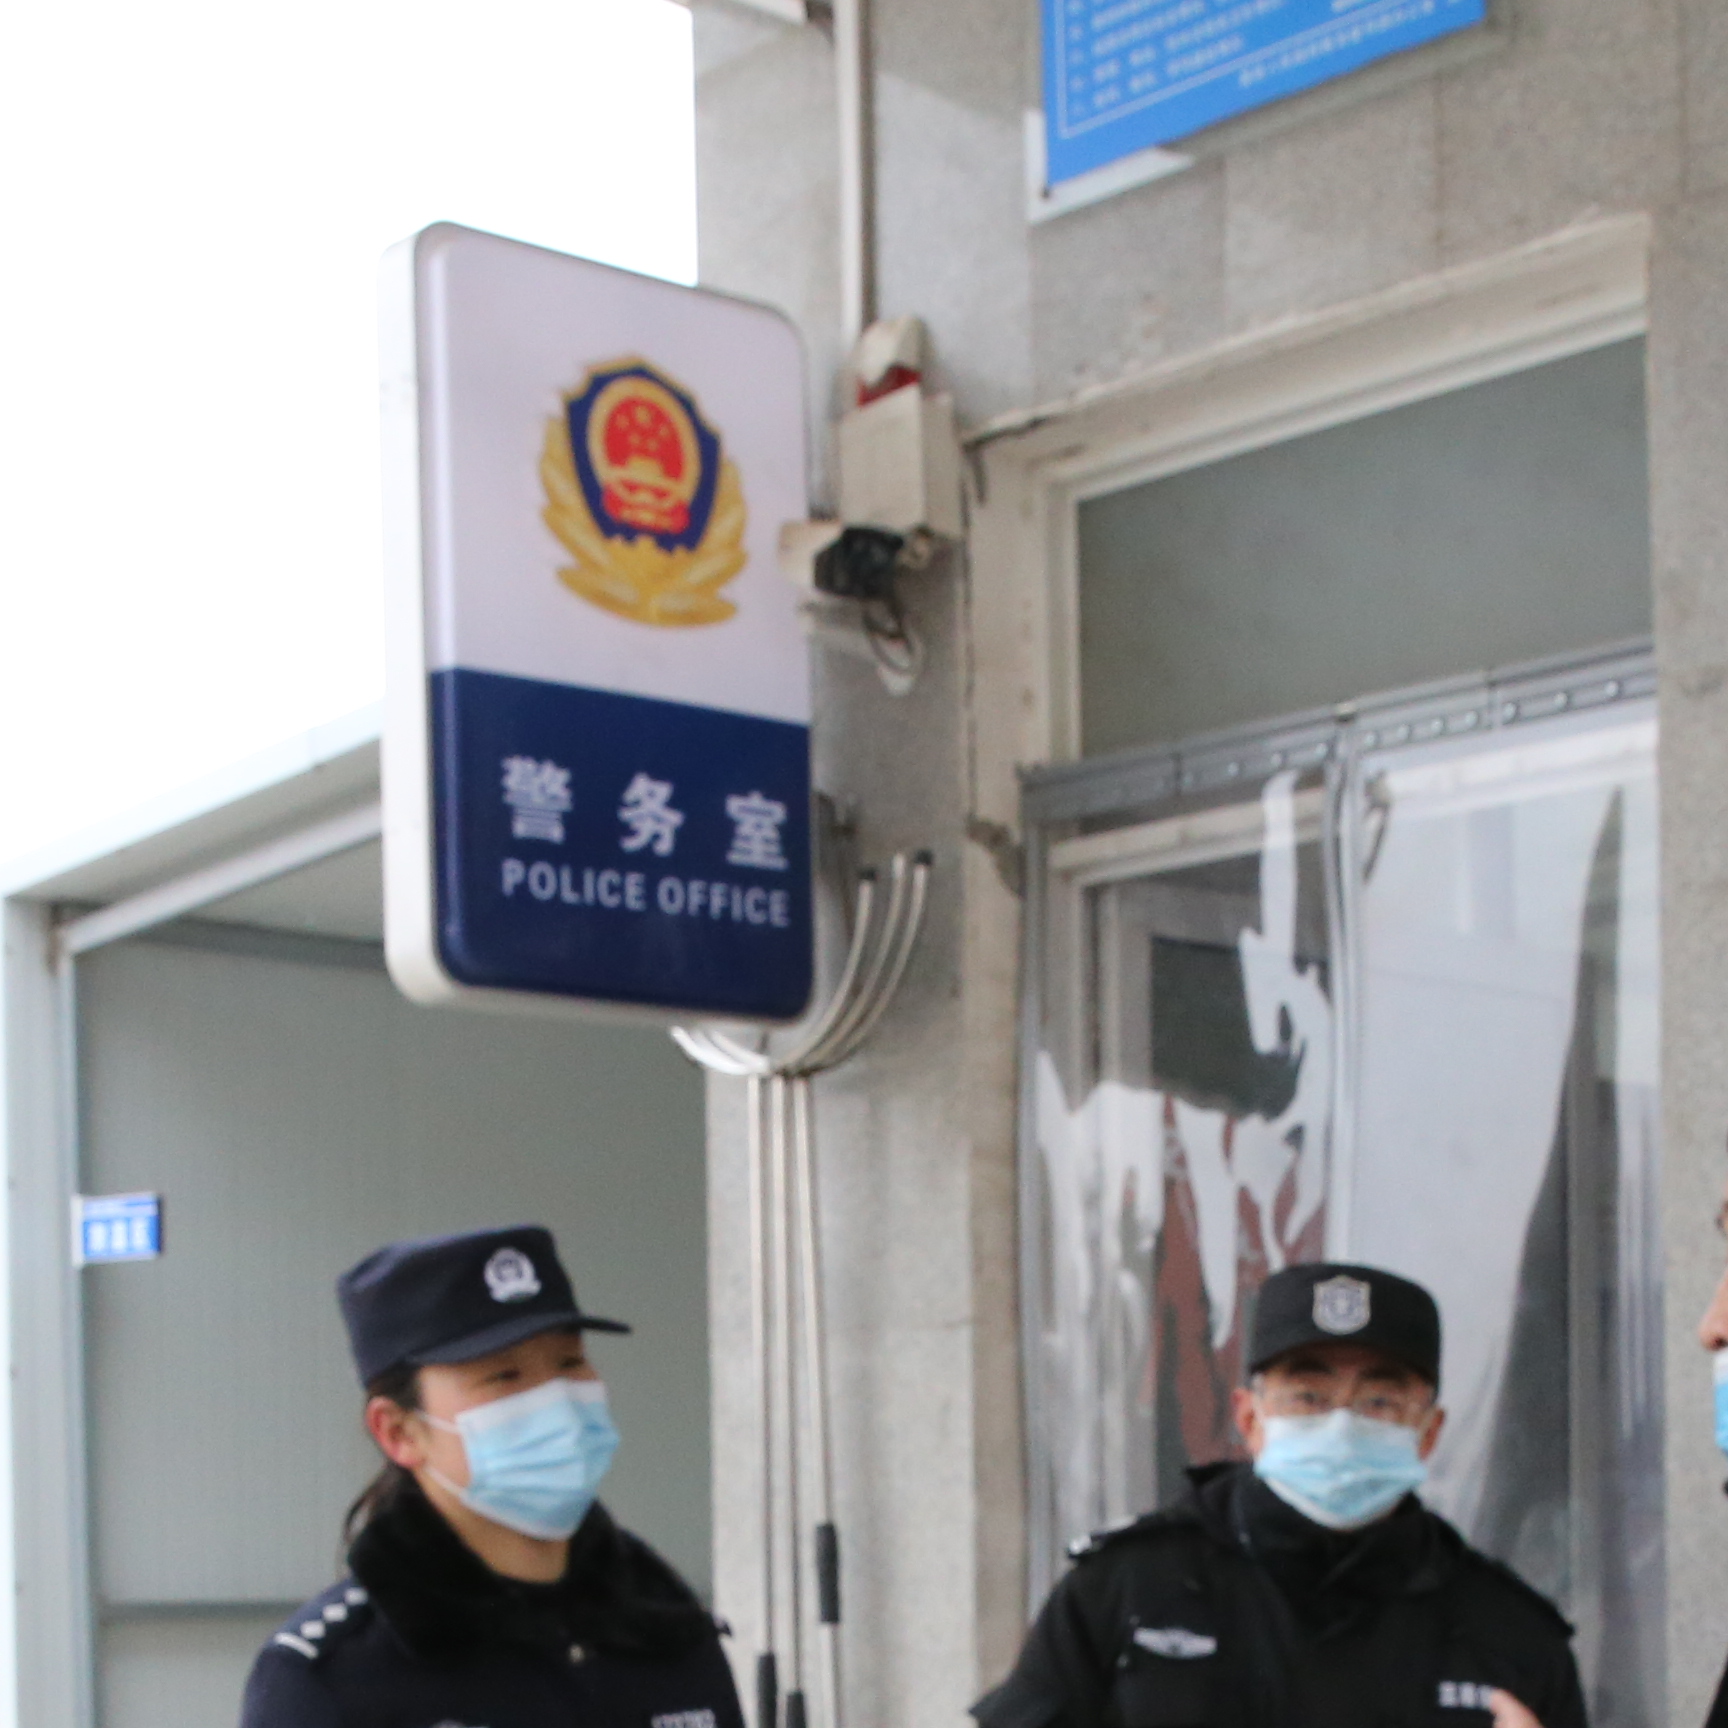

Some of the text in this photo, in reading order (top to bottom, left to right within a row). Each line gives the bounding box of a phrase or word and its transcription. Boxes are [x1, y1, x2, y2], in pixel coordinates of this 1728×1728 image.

[501, 755, 789, 872] 警务室
[501, 857, 791, 928] POLICE OFFICE
